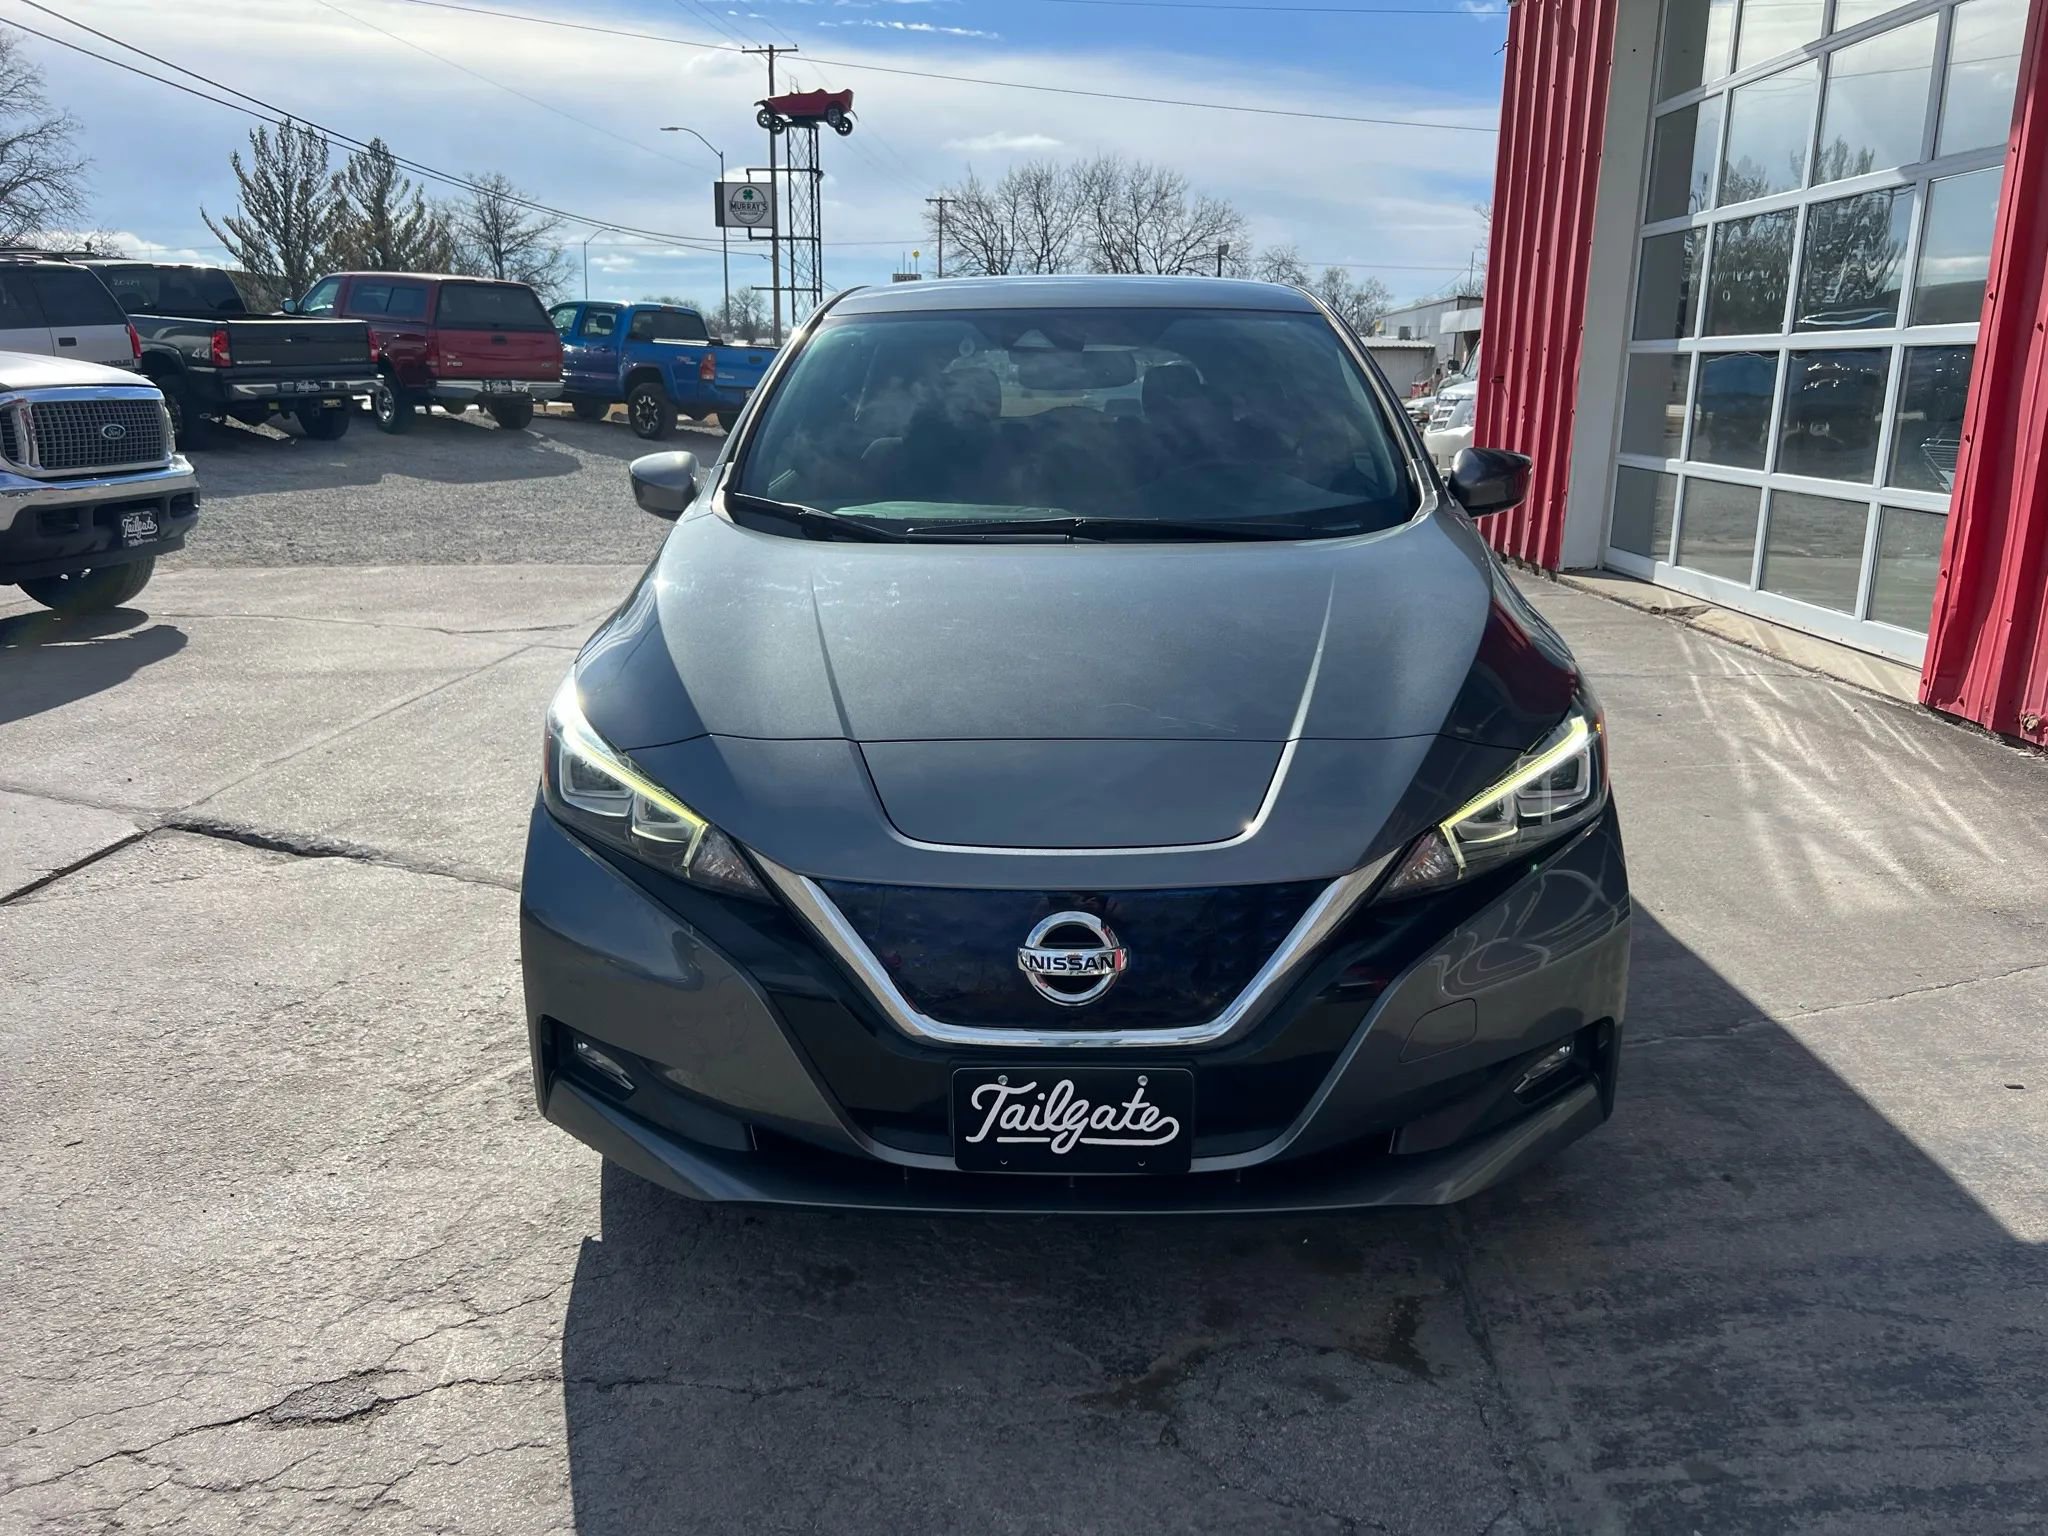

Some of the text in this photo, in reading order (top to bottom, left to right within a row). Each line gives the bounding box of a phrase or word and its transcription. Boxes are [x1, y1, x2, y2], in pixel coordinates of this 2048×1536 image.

[730, 202, 768, 211] MURRAY'S
[122, 515, 158, 539] Tailgate
[1028, 953, 1115, 971] NISSAN
[965, 1078, 1180, 1154] Tailgate
